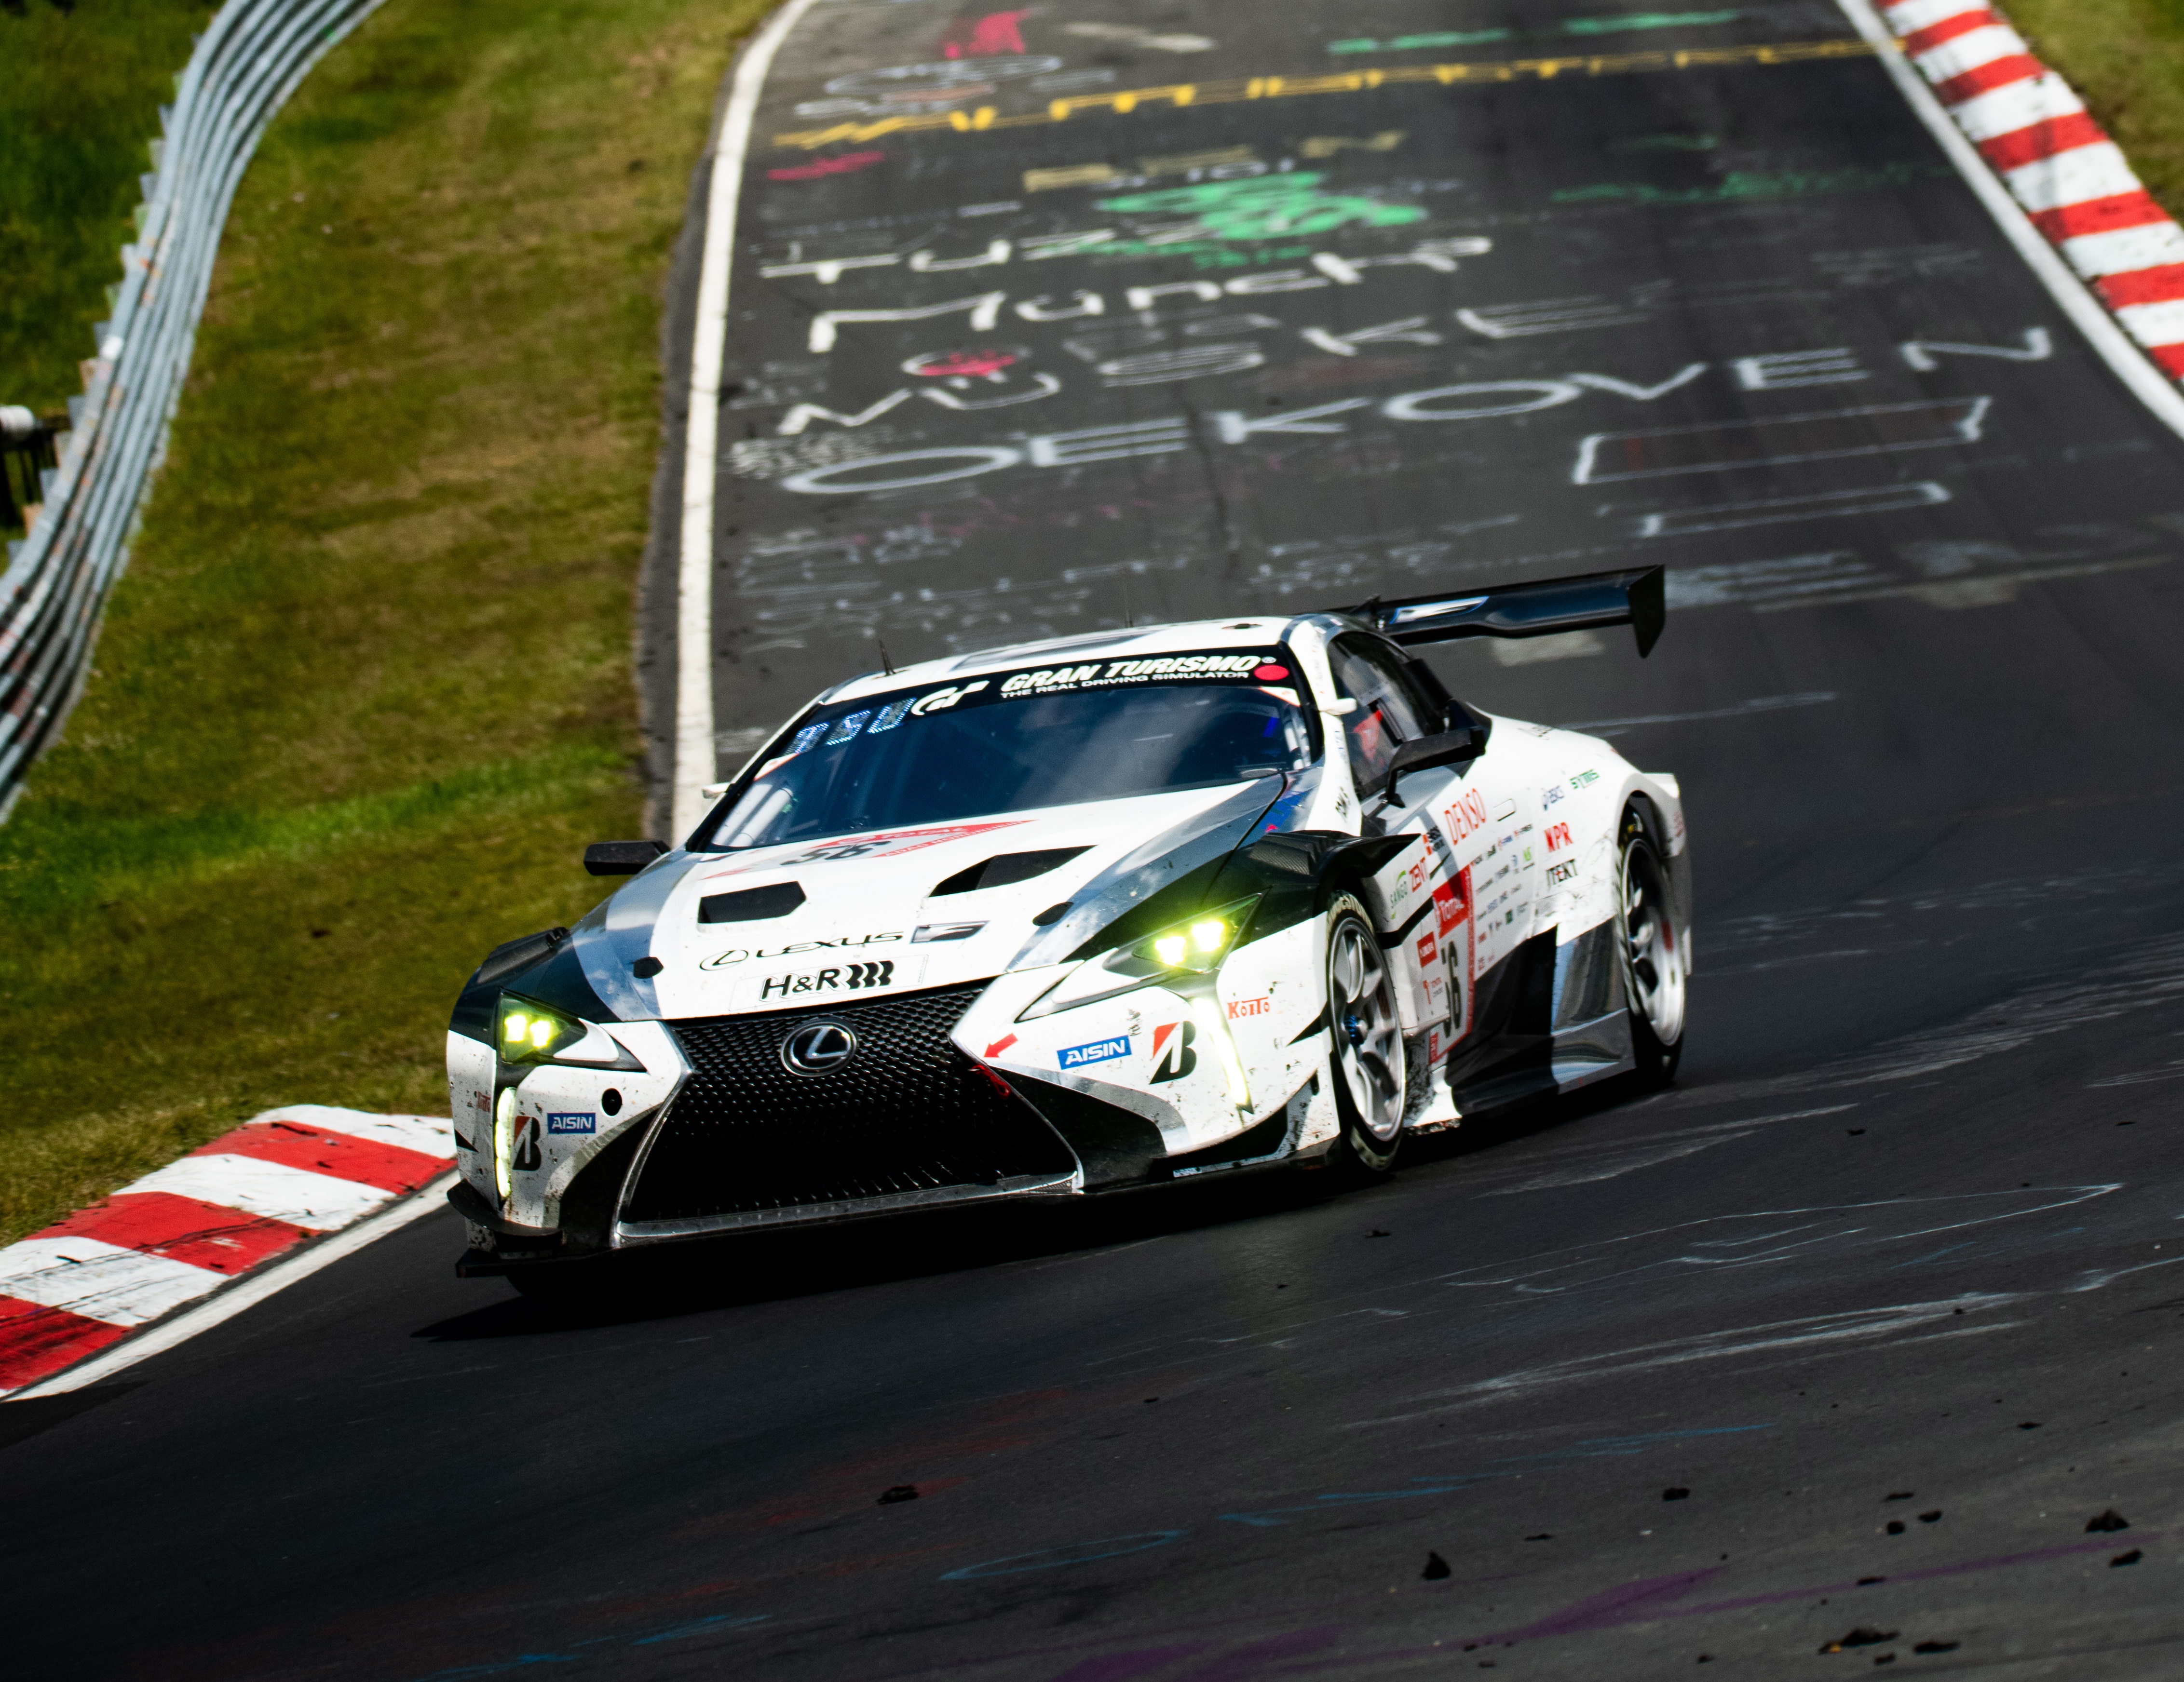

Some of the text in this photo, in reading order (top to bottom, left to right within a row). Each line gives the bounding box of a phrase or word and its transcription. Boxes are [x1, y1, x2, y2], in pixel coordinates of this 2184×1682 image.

[1000, 655, 1263, 693] GRAN TURISMO
[1000, 671, 1250, 699] THE REAL DRIVING SIMULATOR
[1444, 787, 1487, 846] DENSO
[756, 931, 904, 959] LEXUS
[760, 966, 843, 1001] H&R
[1065, 1040, 1126, 1066] AISIN
[551, 1116, 593, 1130] AISIN
